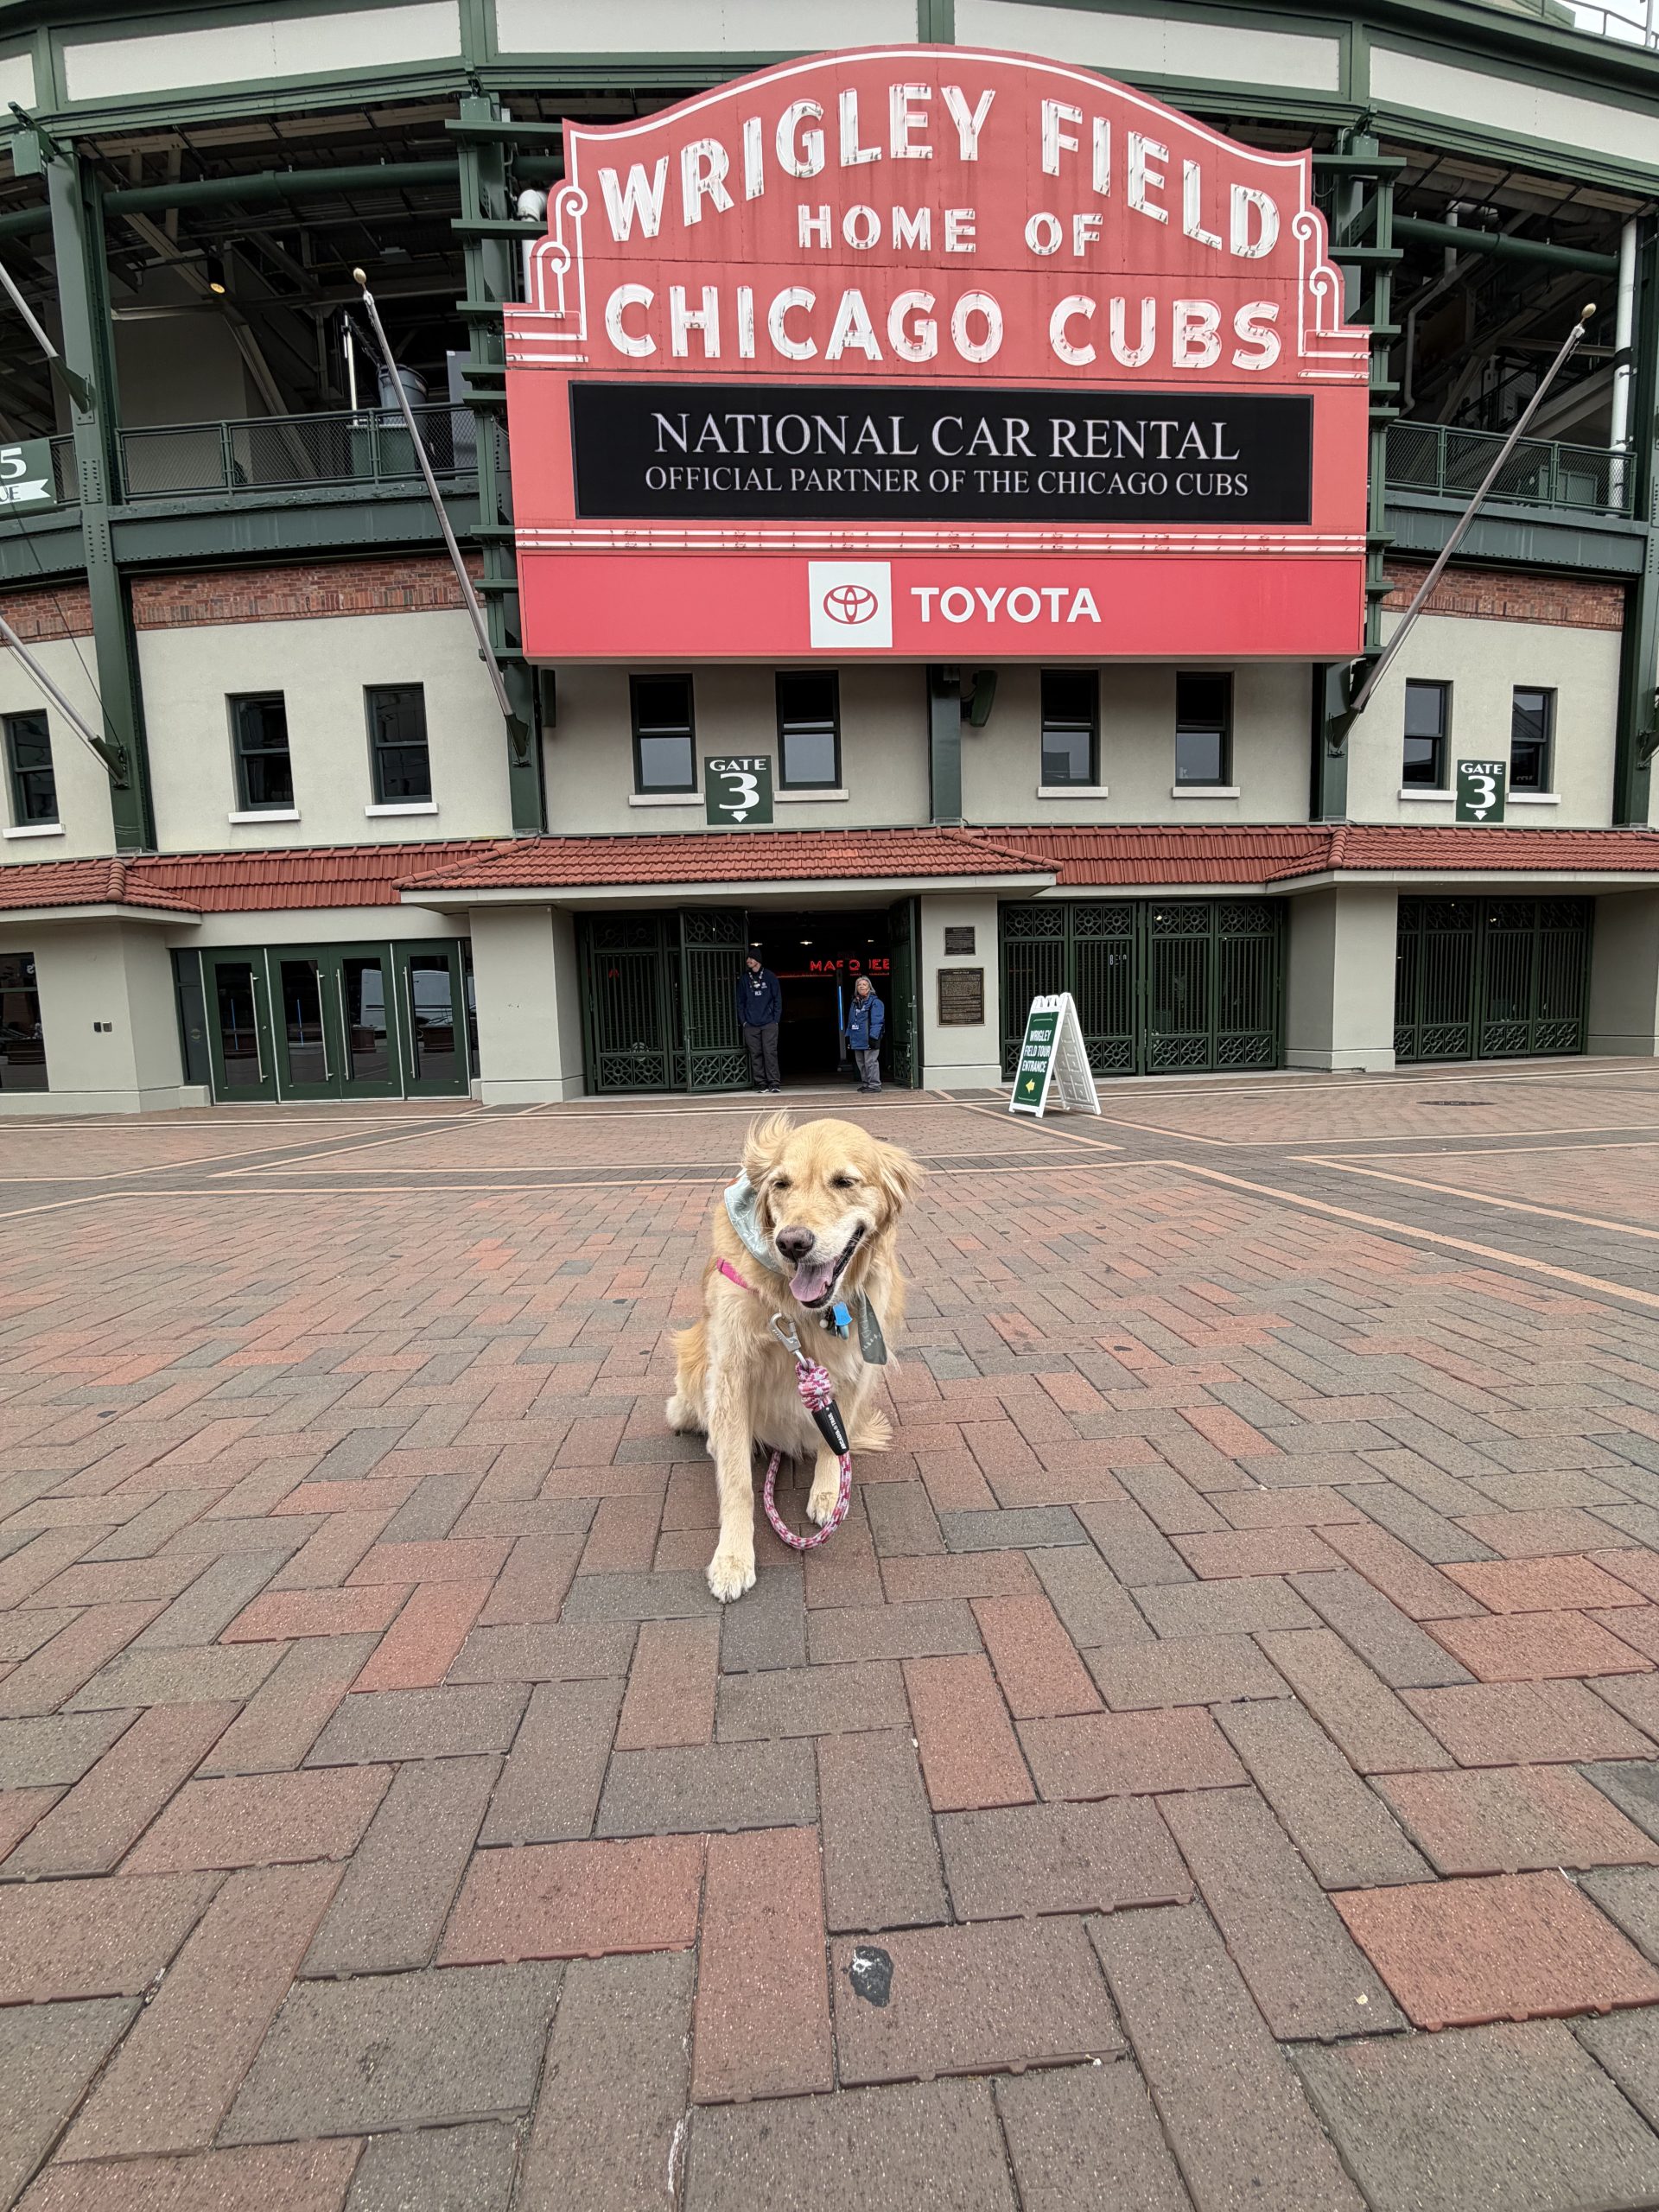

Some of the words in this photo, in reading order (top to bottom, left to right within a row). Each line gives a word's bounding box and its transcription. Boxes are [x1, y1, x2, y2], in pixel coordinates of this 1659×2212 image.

[598, 83, 996, 243] WRIGLEY
[1041, 98, 1281, 260] FIELD
[797, 203, 977, 254] HOME
[1024, 212, 1104, 257] OF
[603, 283, 1004, 364] CHICAGO
[1049, 295, 1282, 372] CUBS
[650, 413, 919, 455] NATIONAL
[931, 416, 1036, 457] CAR
[1048, 418, 1241, 460] RENTAL
[645, 466, 784, 492] OFFICIAL
[790, 468, 921, 493] PARTNER
[929, 469, 967, 493] OF
[974, 469, 1030, 494] THE
[1037, 470, 1168, 495] CHICAGO
[1176, 473, 1249, 497] CUBS
[910, 586, 1103, 624] TOYOTA
[709, 759, 767, 772] GATE
[1460, 762, 1503, 775] GATE
[719, 772, 760, 810] 3
[1465, 775, 1497, 809] 3
[1024, 1045, 1037, 1057] FIELD
[1037, 1045, 1051, 1058] TOUR
[1029, 1029, 1052, 1042] WRIGLEY
[1021, 1059, 1047, 1073] ENTRANCE
